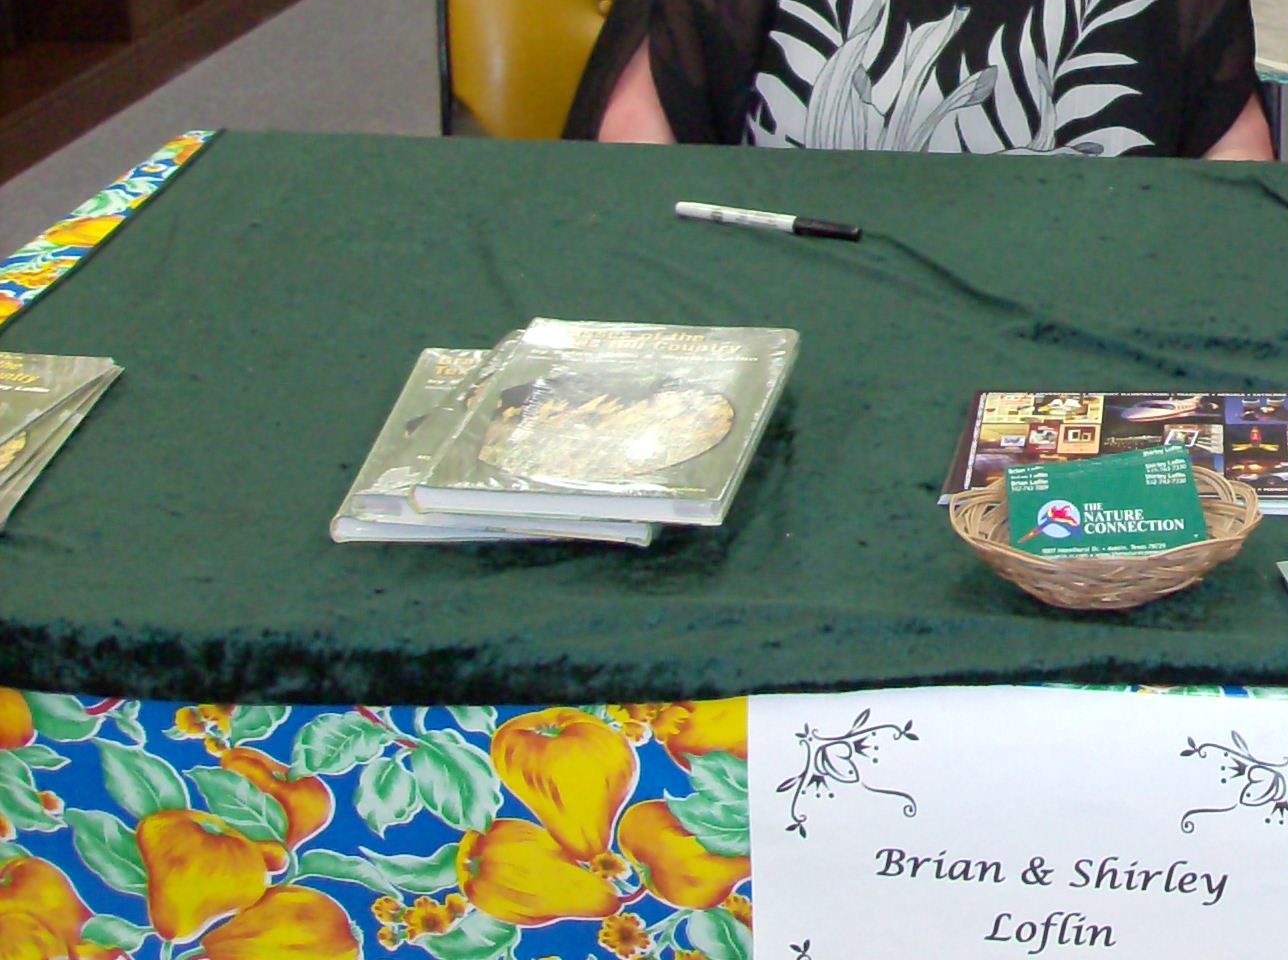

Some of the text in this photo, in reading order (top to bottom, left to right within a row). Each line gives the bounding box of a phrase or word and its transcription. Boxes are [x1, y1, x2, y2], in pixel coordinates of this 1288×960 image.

[653, 340, 742, 354] Country
[1083, 502, 1104, 511] THE
[1084, 509, 1145, 523] NATURE
[1083, 518, 1185, 535] CONNECTION
[874, 848, 1229, 907] Brian & Shirley
[983, 911, 1117, 956] Loflin
